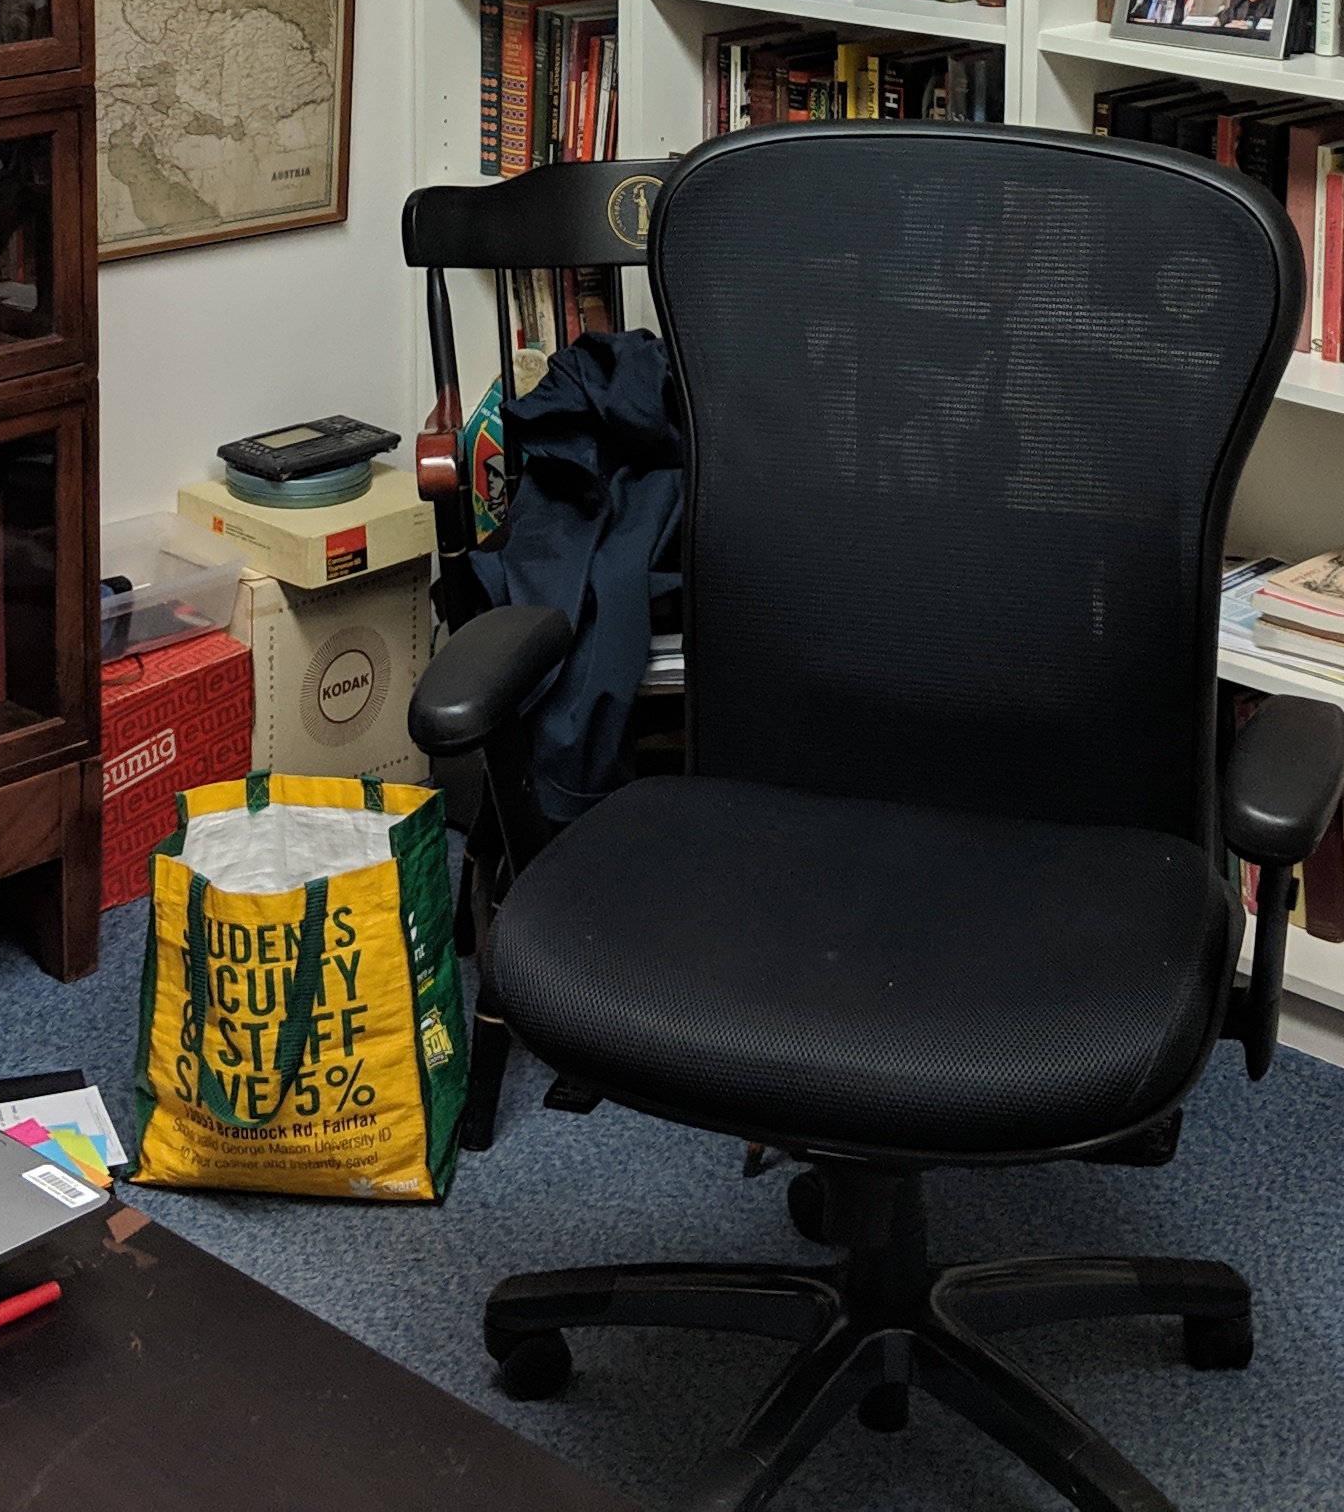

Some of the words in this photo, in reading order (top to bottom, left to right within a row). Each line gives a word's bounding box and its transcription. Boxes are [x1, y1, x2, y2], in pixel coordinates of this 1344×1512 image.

[322, 673, 370, 702] KODAK
[217, 1004, 368, 1072] STFF
[294, 1058, 376, 1118] 5%
[216, 1123, 286, 1140] Braddock
[322, 1111, 377, 1134] Fairfax
[222, 1139, 266, 1155] George
[269, 1137, 310, 1154] Mason
[314, 1129, 376, 1154] University
[378, 1126, 392, 1145] ID
[290, 1156, 342, 1170] instantly
